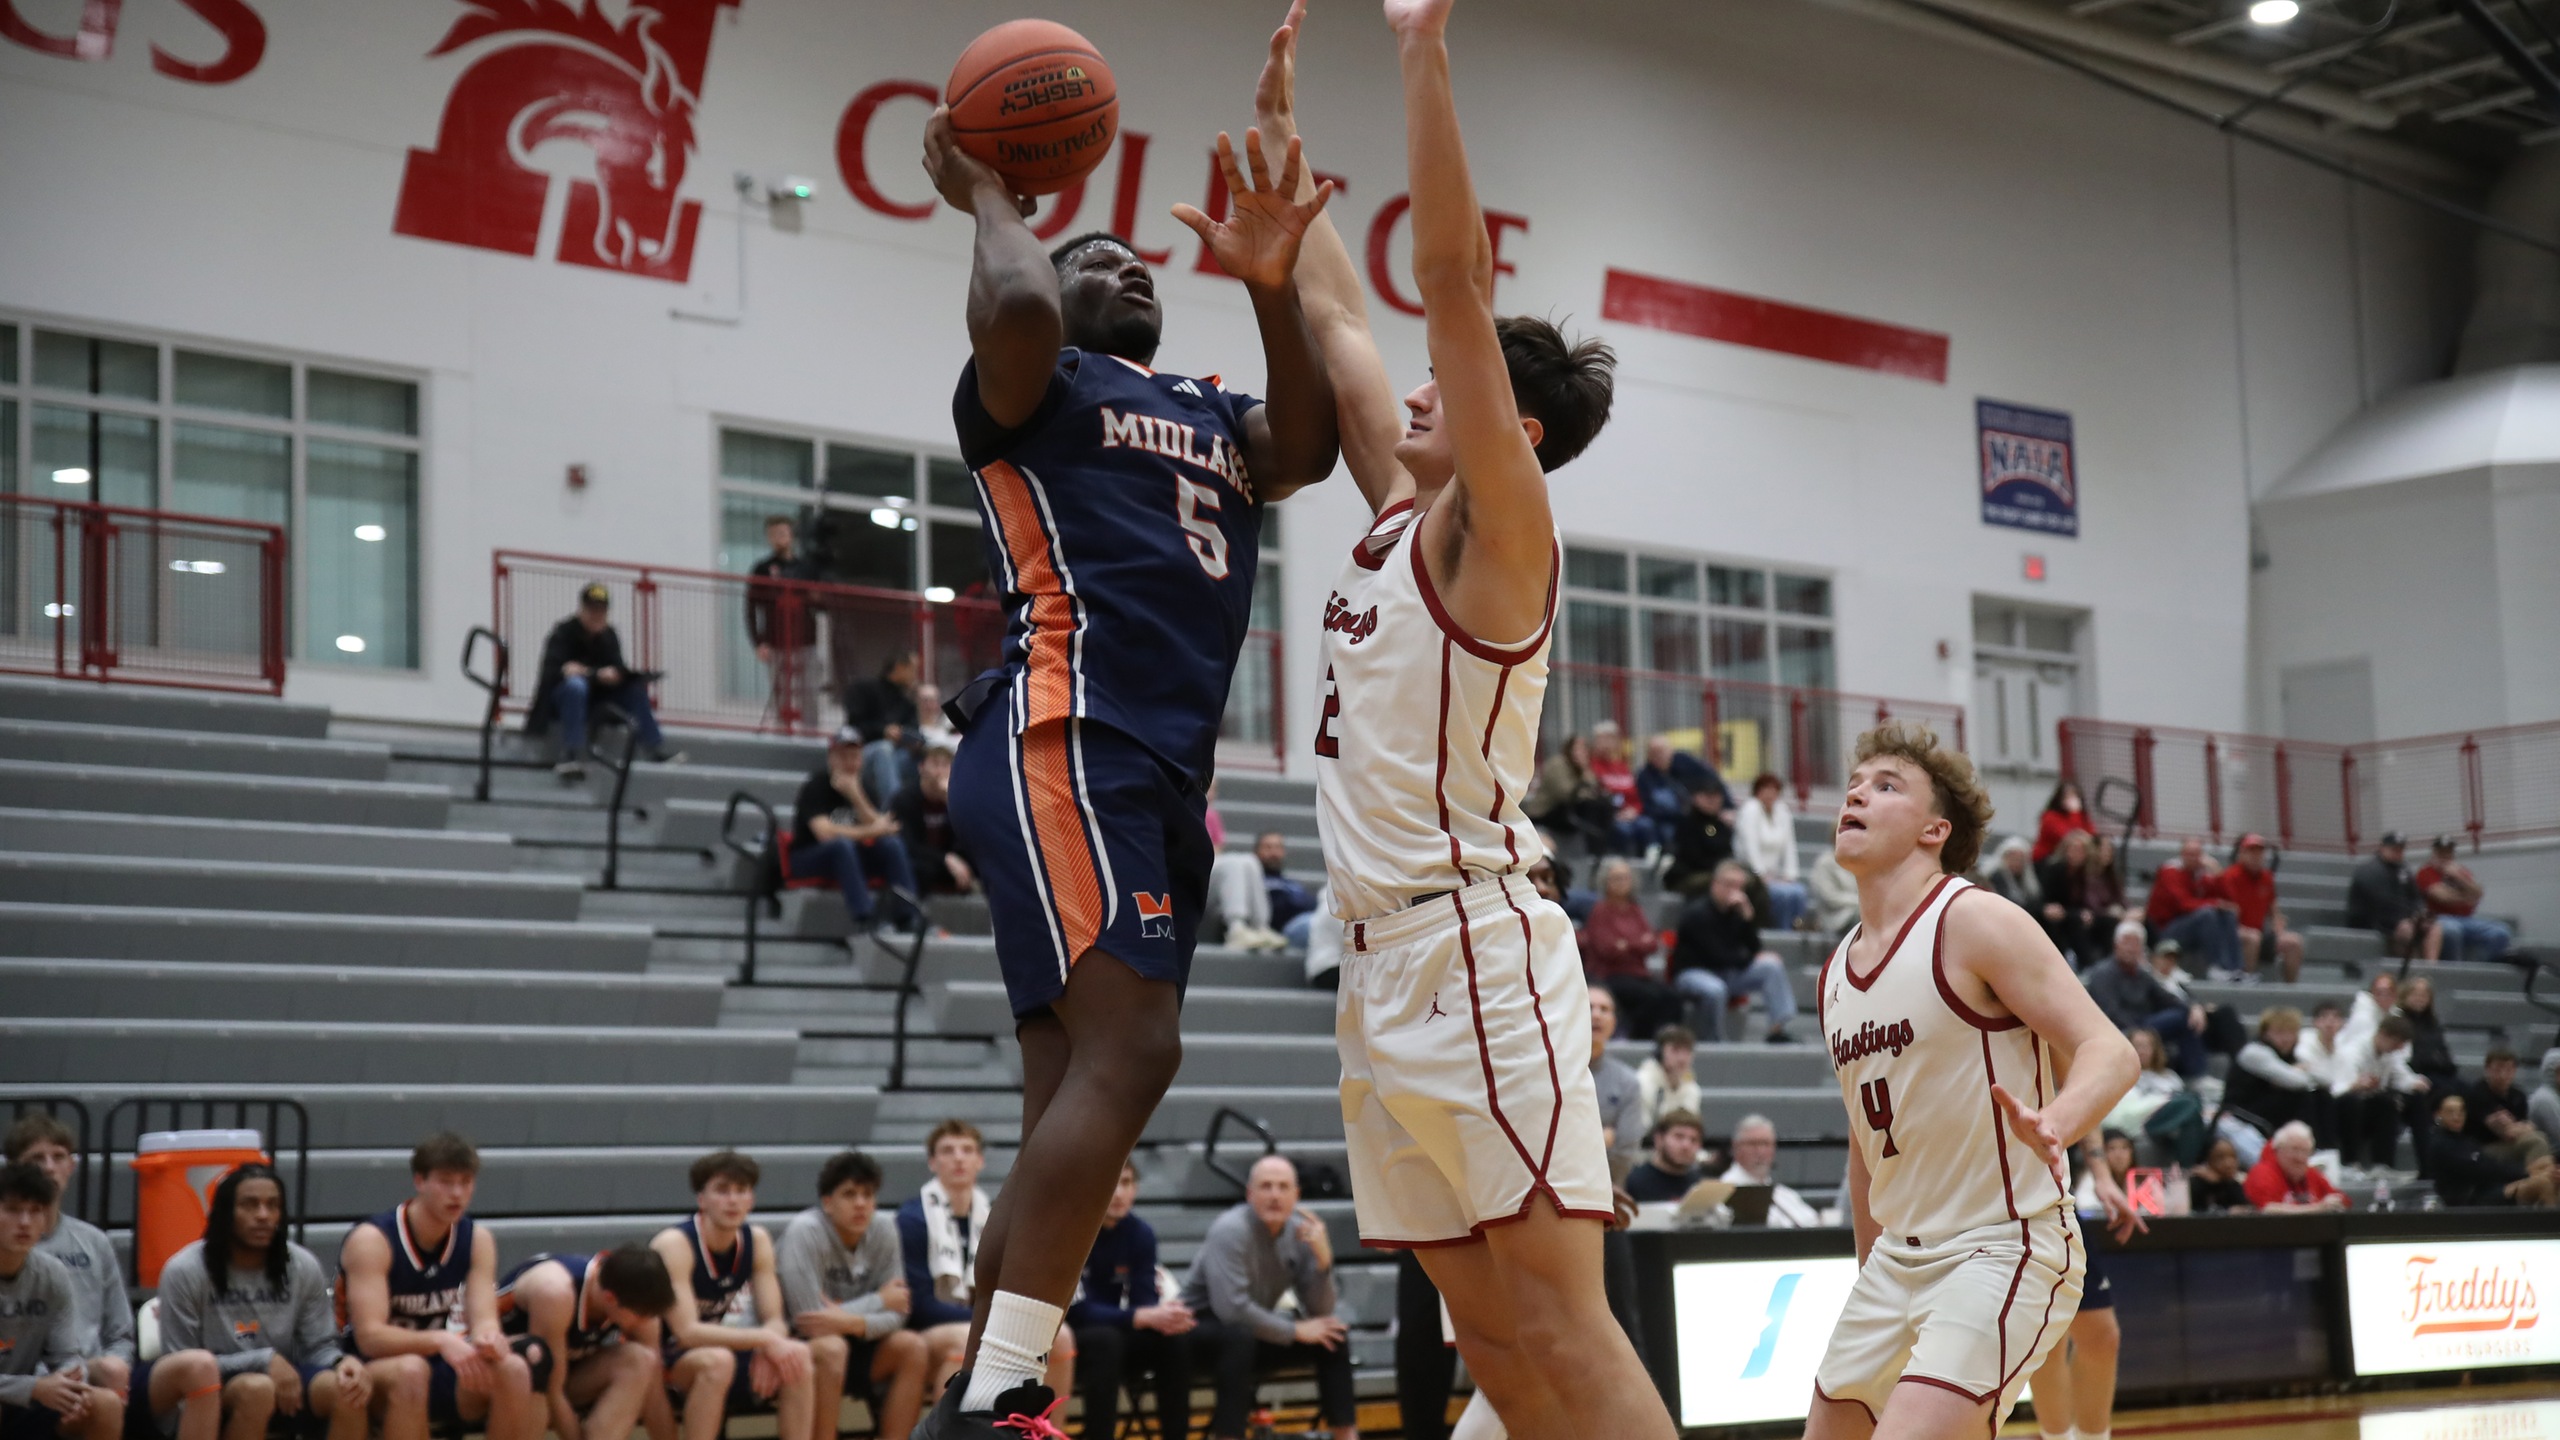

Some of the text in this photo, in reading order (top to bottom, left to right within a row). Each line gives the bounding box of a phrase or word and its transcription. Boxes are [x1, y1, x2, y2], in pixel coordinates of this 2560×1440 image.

[999, 79, 1096, 116] LEGACY
[997, 113, 1108, 164] SPALDING
[1176, 473, 1231, 581] 5
[1832, 1018, 1915, 1071] Hastings
[1860, 1077, 1900, 1159] 4
[2402, 1254, 2538, 1326] Freddy's
